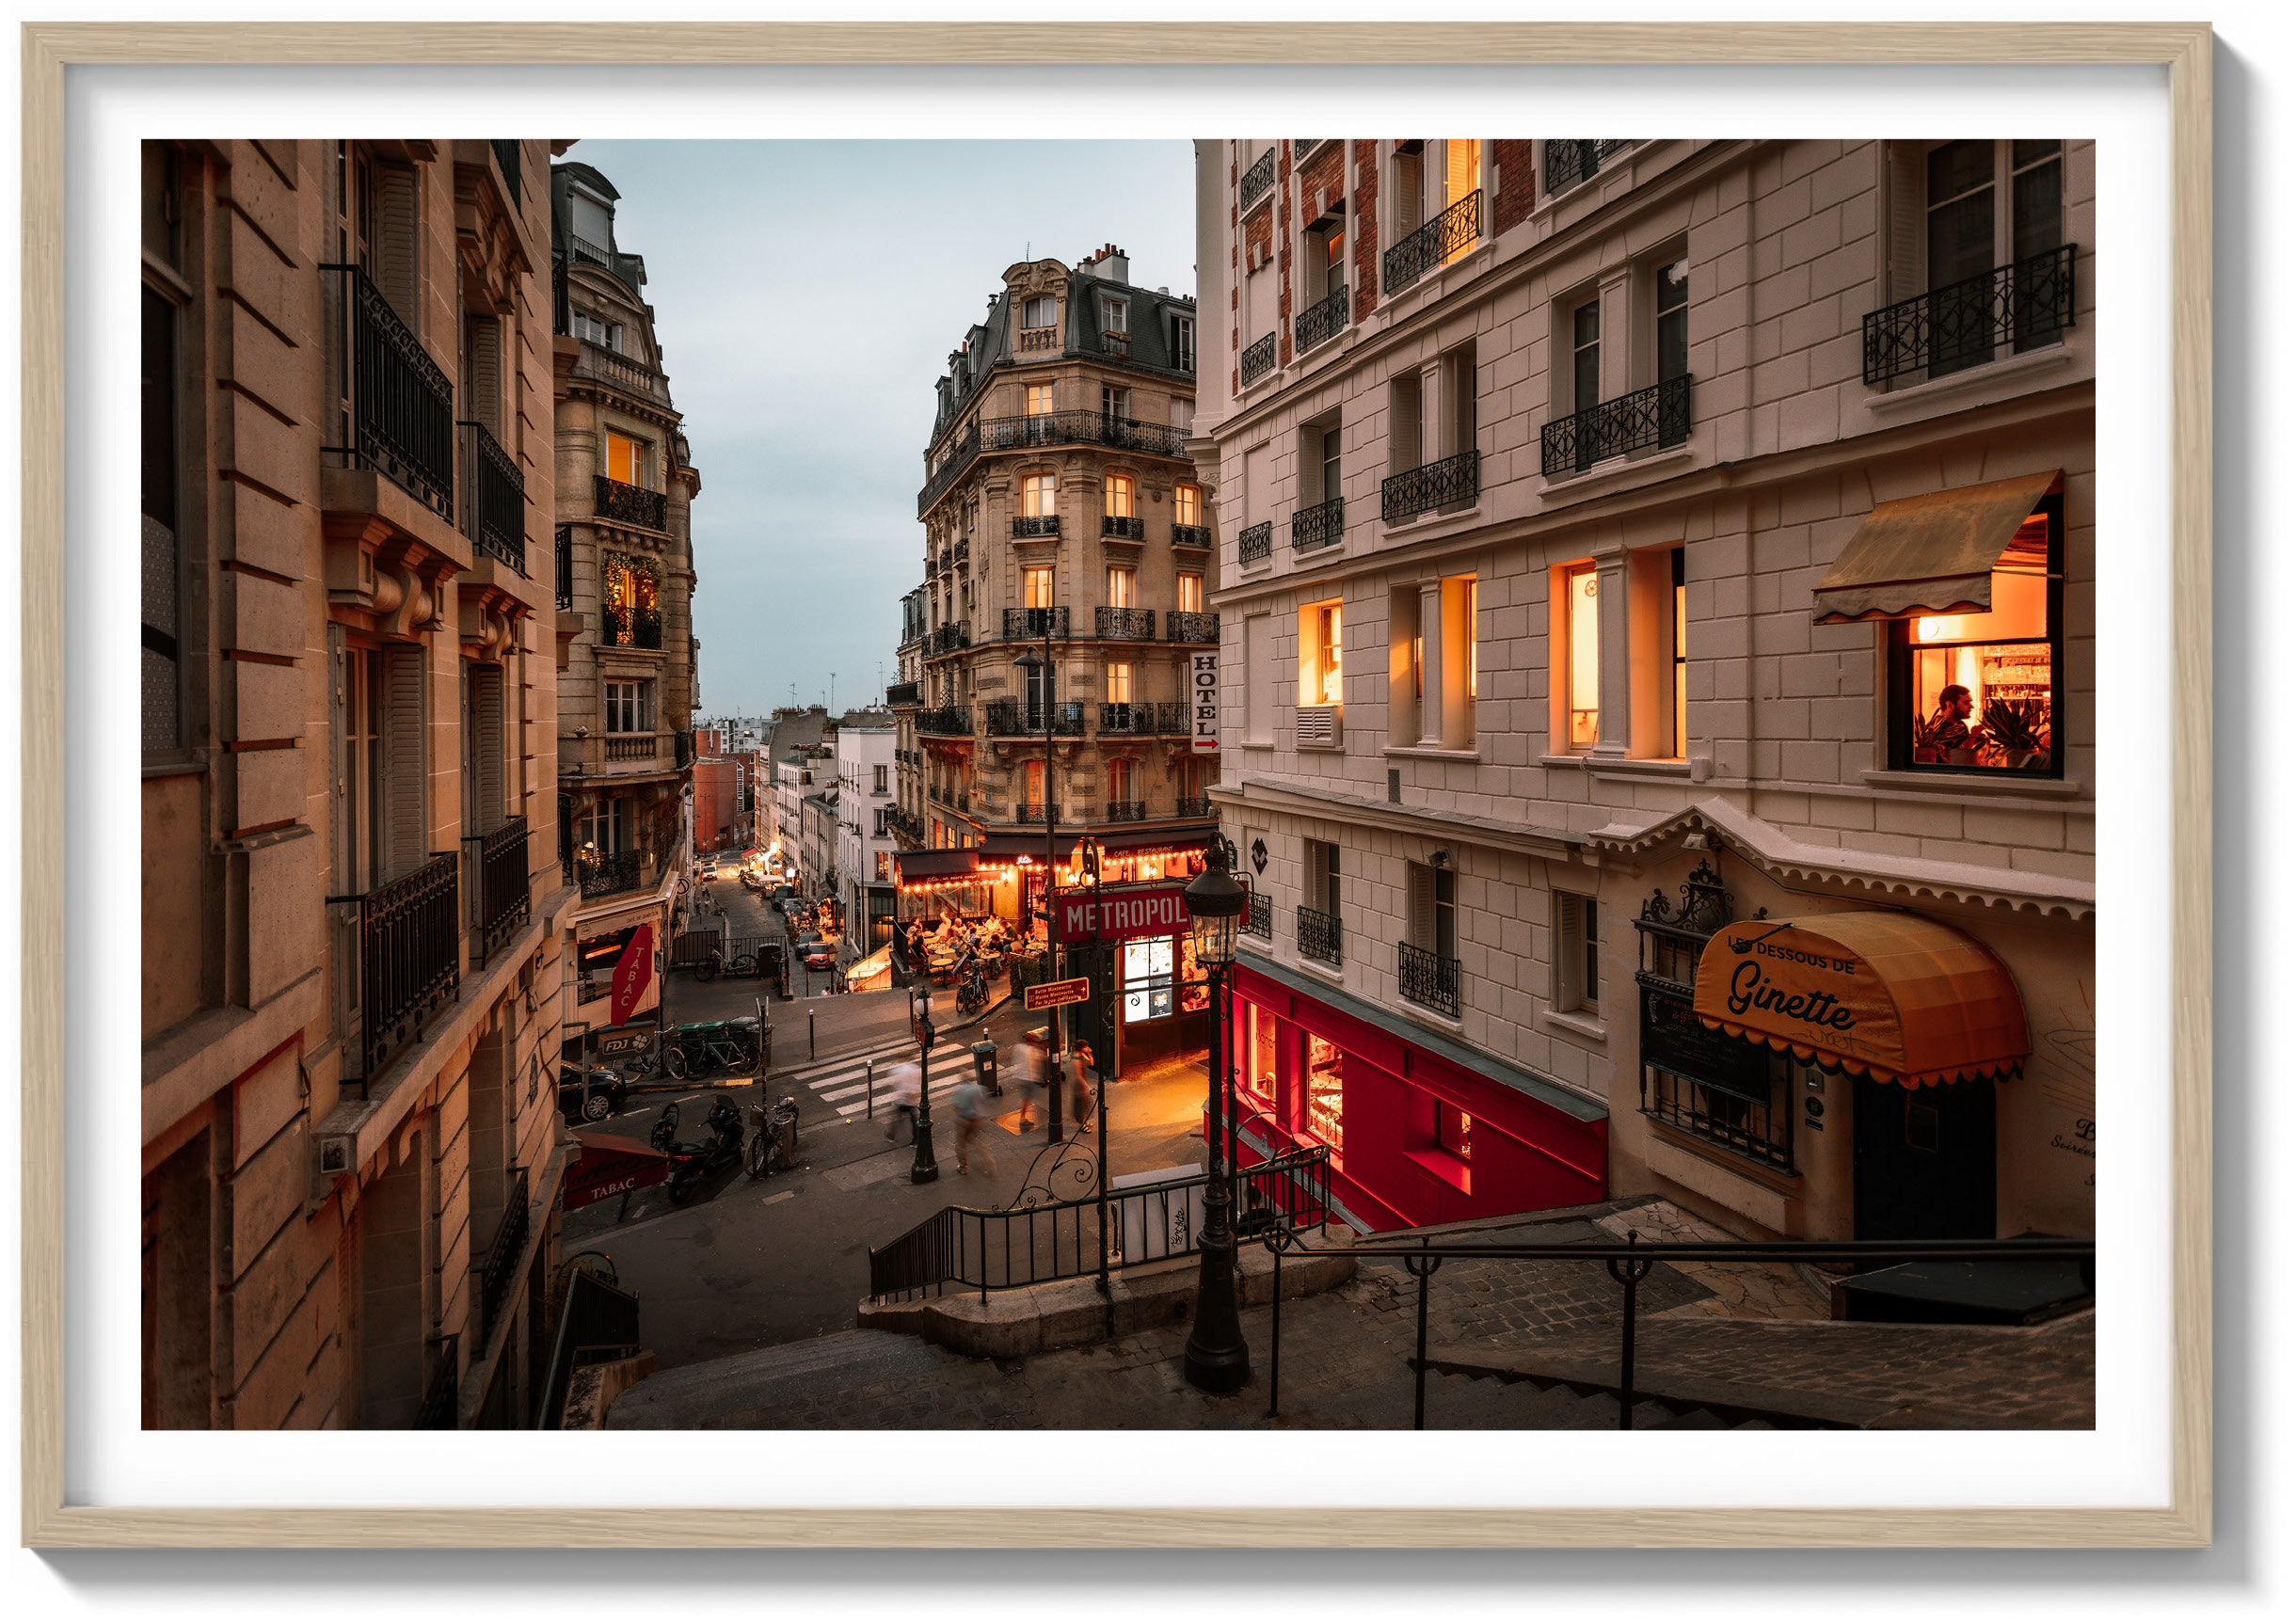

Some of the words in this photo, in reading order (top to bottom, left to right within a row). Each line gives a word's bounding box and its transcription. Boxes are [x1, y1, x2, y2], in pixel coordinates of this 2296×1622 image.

[1194, 656, 1217, 736] HOTEL
[1138, 846, 1173, 855] RESTAURANT
[1066, 897, 1188, 933] METROPOL
[1728, 935, 1753, 948] LE
[1757, 942, 1827, 969] DESSOUS
[1833, 958, 1856, 975] DE
[620, 946, 646, 1006] TABAC
[1728, 960, 1857, 1031] Ginette
[605, 1039, 629, 1052] FDJ
[591, 1178, 635, 1200] TABAC
